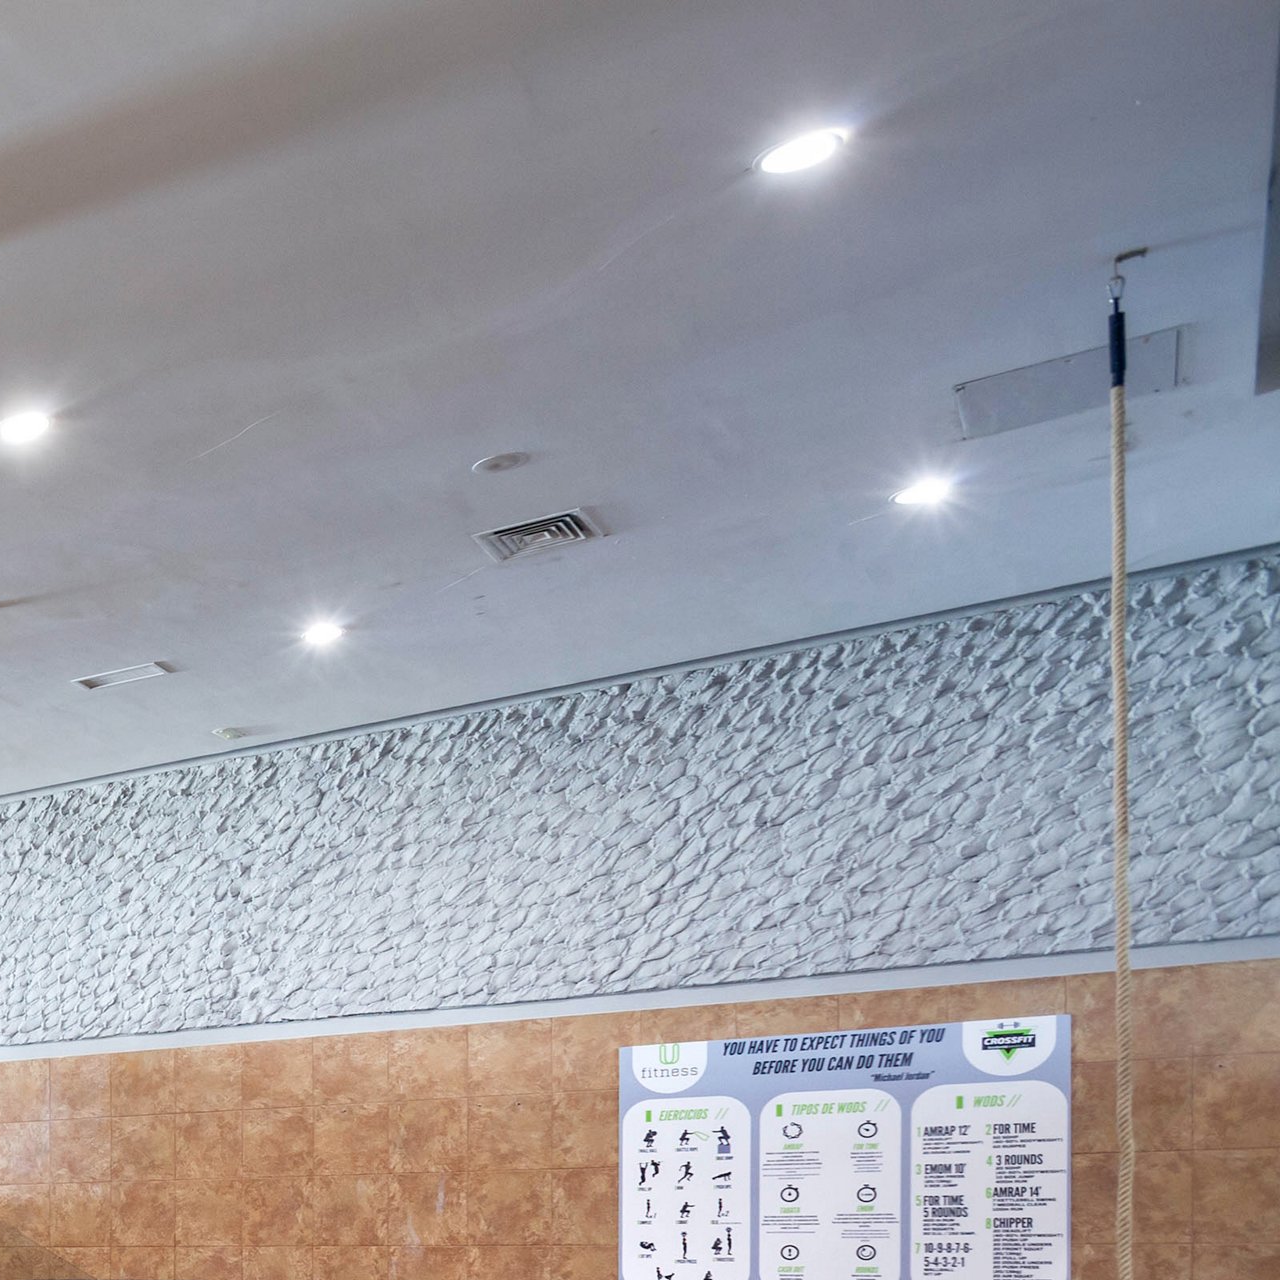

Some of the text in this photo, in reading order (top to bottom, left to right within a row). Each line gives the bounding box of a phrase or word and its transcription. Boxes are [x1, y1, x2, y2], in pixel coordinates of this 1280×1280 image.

[723, 1028, 946, 1056] YOU HAVE TO EXPECT THINGS OF YOU
[984, 1036, 1034, 1046] CROSSFIT
[752, 1052, 914, 1075] BEFORE YOU CAN DO THEM
[641, 1065, 698, 1079] fitness
[973, 1095, 1004, 1108] WODS
[791, 1101, 867, 1116] TIPOS DE WODS
[659, 1109, 708, 1121] EJERCICIOS
[923, 1125, 956, 1136] AMRAP
[993, 1123, 1011, 1134] FOR
[1013, 1122, 1036, 1133] TIME
[996, 1155, 1002, 1165] 3
[1004, 1154, 1043, 1165] ROUNDS
[924, 1163, 952, 1174] EMOM
[992, 1186, 1027, 1197] AMRAP
[923, 1195, 940, 1206] FOR
[942, 1195, 964, 1205] TIME
[923, 1207, 968, 1217] 5 ROUNDS
[993, 1217, 1033, 1228] CHIPPER
[924, 1256, 965, 1267] 5-4-3-2-1
